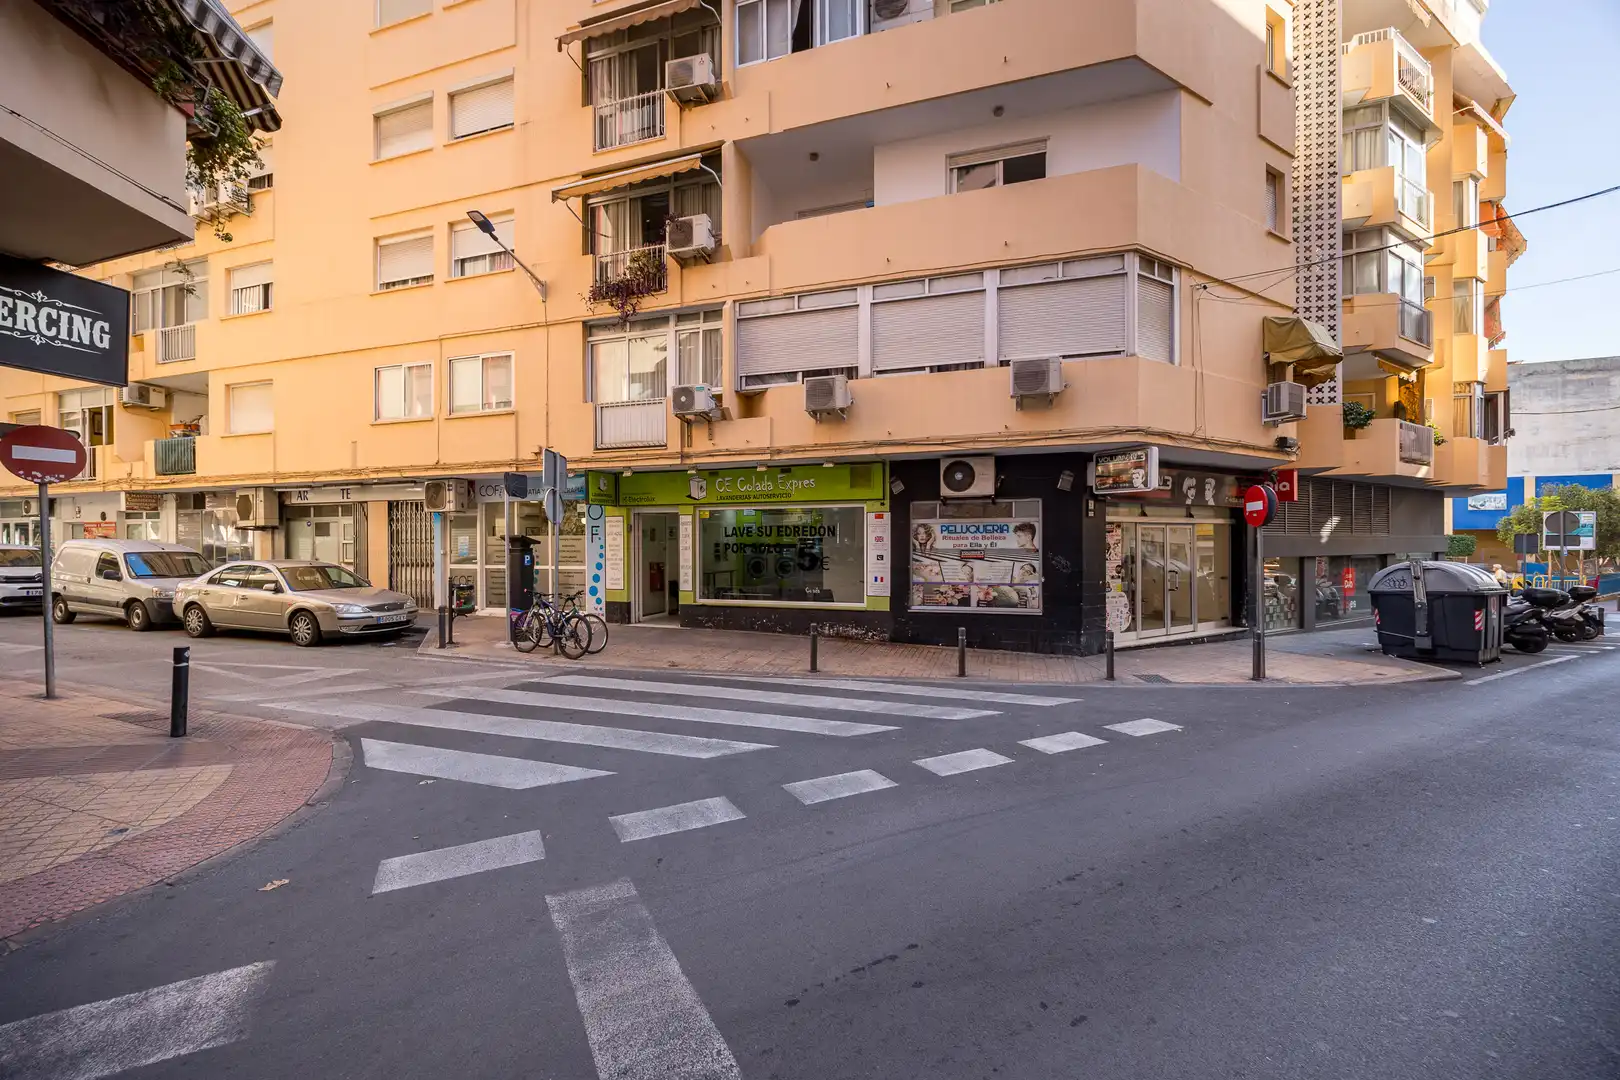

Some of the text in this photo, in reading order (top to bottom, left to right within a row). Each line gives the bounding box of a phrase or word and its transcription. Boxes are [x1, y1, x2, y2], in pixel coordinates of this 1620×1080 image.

[0, 295, 111, 349] ERCING
[716, 474, 816, 494] CE Colada Expres
[753, 492, 792, 500] AUTOSERVICIO
[724, 526, 753, 538] LAVE
[756, 526, 773, 537] SU
[724, 543, 746, 554] POR
